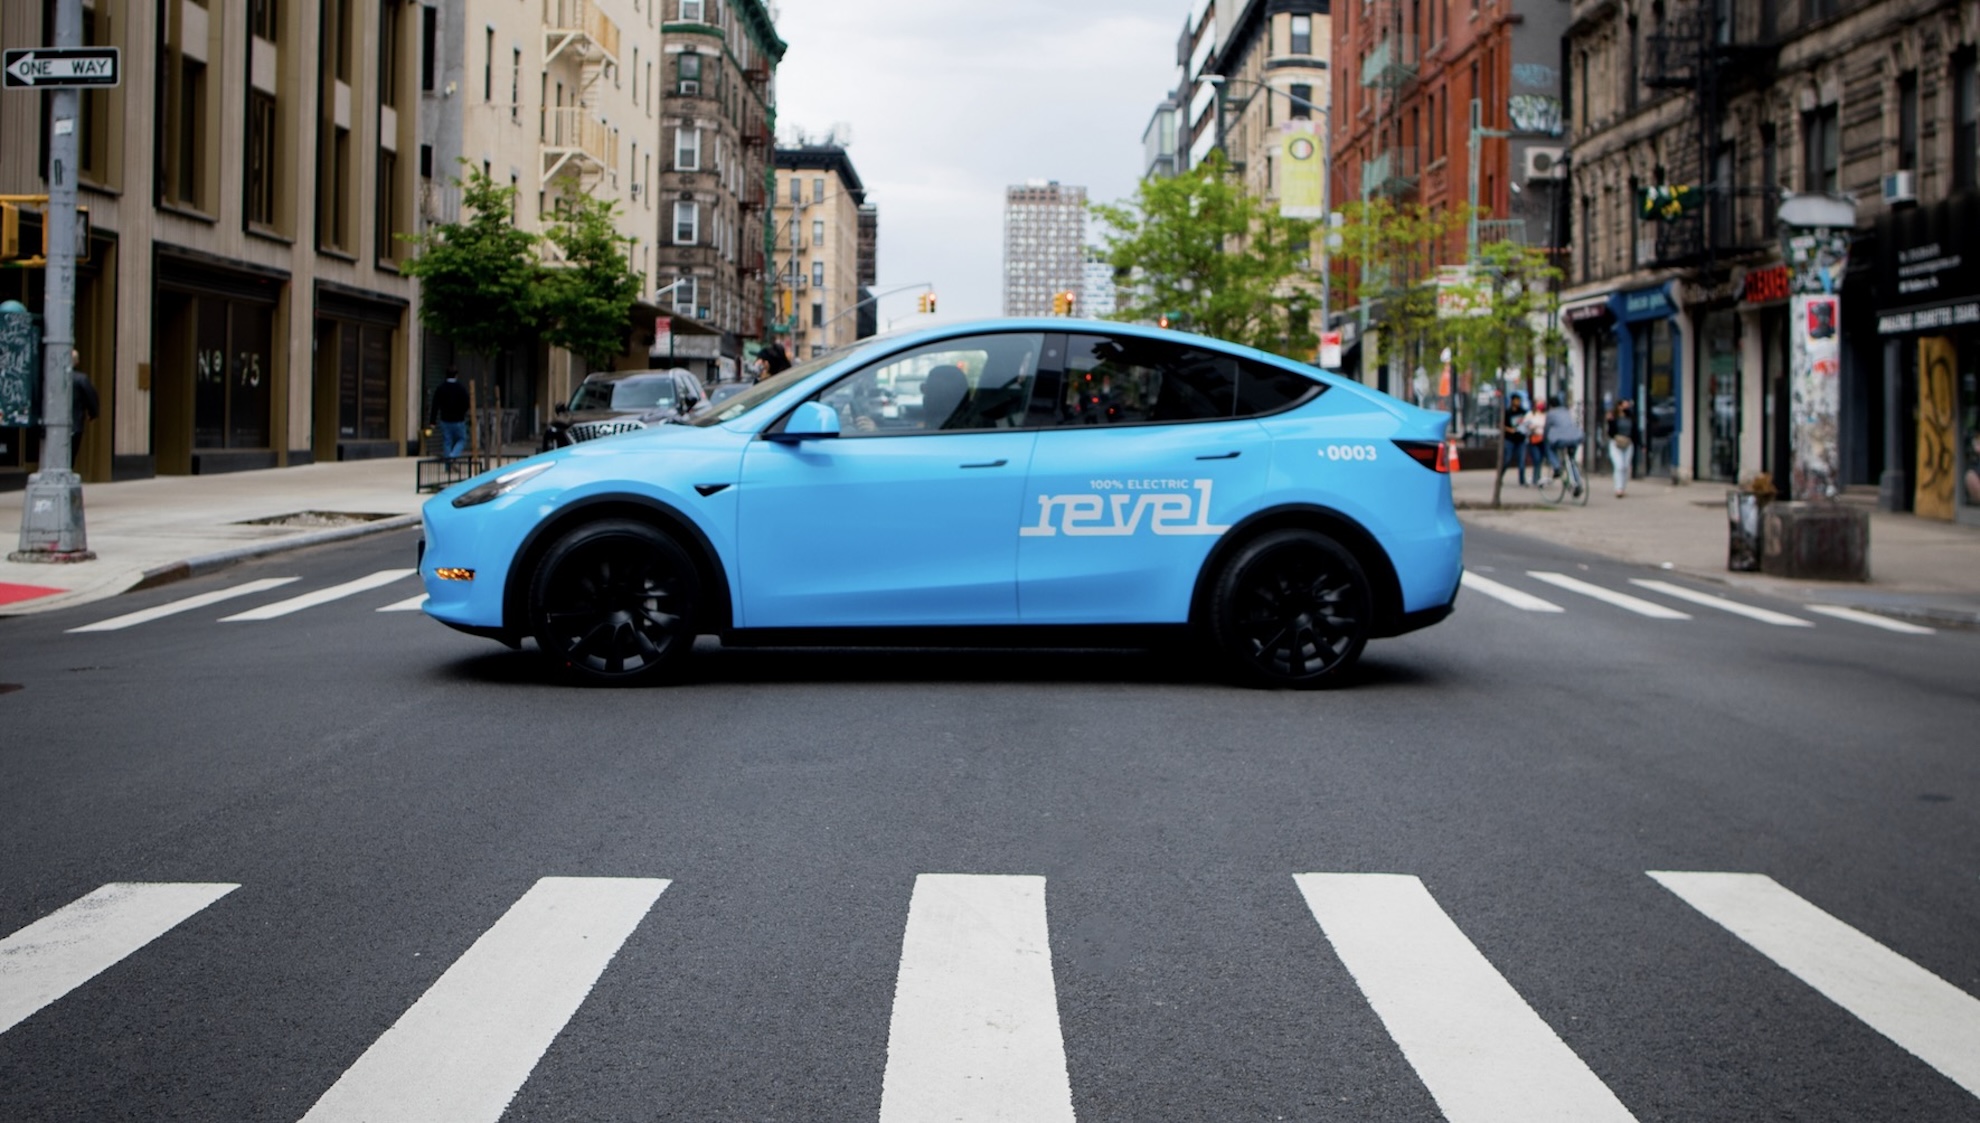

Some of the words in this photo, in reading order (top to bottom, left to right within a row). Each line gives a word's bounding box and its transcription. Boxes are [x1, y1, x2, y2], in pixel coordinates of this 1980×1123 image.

[19, 60, 52, 76] ONE
[71, 60, 107, 75] WAY
[240, 351, 260, 387] 75
[1327, 444, 1377, 461] 0003
[1090, 480, 1123, 489] 100%
[1127, 479, 1189, 489] ELECTRIC
[1019, 479, 1233, 537] revel
